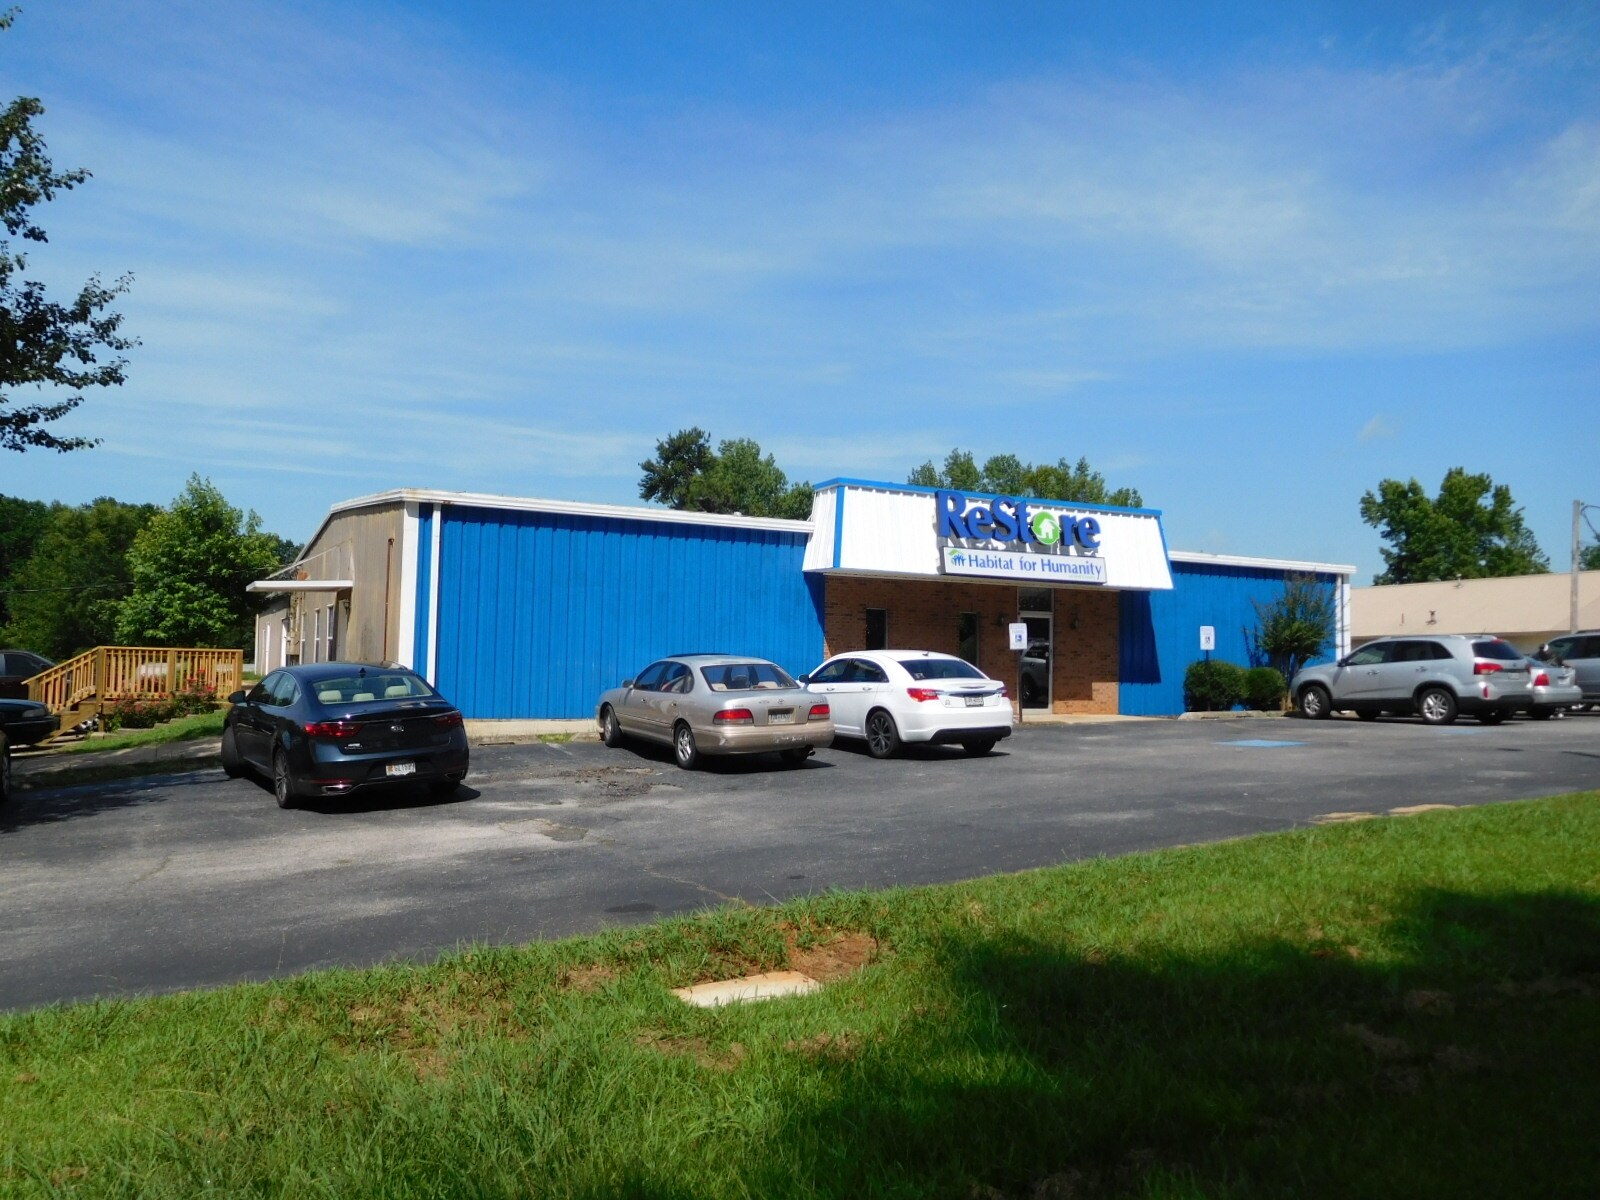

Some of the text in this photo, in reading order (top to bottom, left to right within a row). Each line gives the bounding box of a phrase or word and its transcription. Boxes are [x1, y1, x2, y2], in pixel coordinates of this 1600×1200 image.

[935, 490, 1101, 549] ReStore
[968, 554, 1102, 580] Habitat for Humanity
